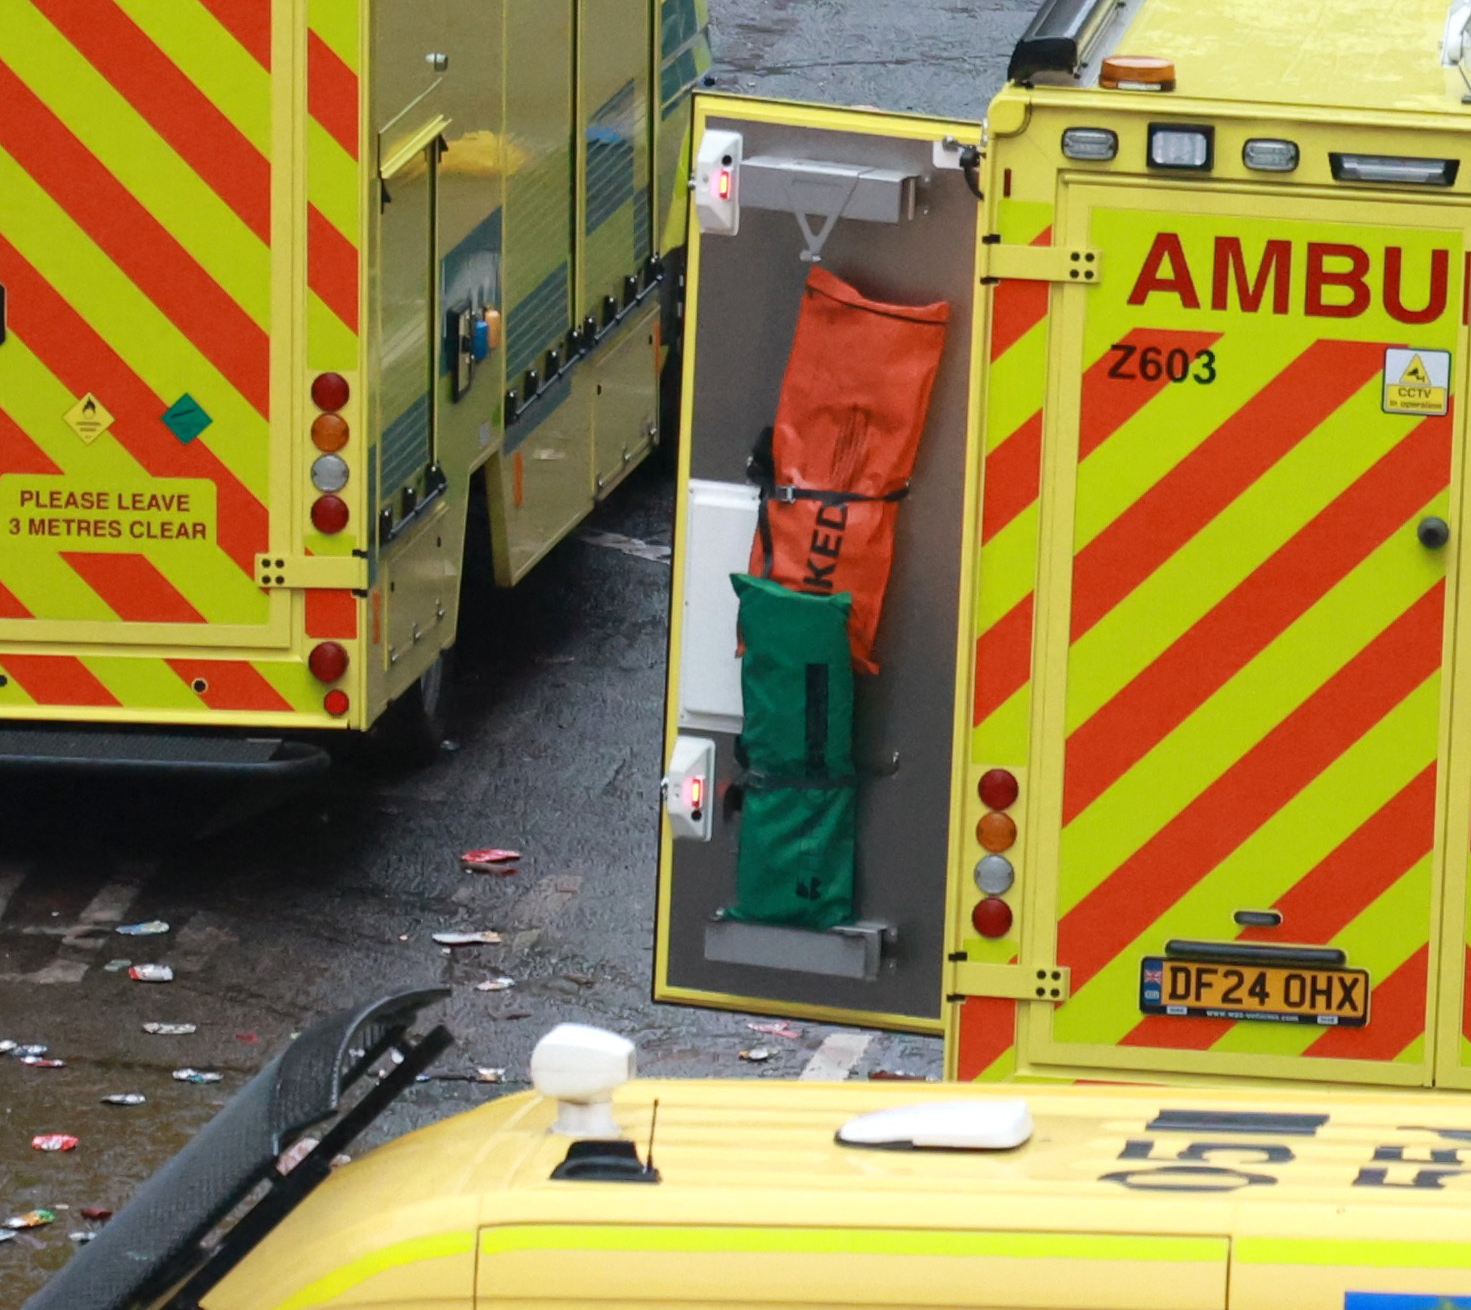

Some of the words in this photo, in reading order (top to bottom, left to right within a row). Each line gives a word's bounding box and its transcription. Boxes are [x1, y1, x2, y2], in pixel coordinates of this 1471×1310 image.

[1108, 344, 1216, 385] Z603
[1398, 387, 1432, 399] CCTV
[1400, 401, 1442, 411] operation
[20, 490, 109, 510] PLEASE
[118, 493, 190, 512] LEAVE
[9, 518, 20, 535] 3
[29, 518, 122, 538] METRES
[130, 521, 206, 540] CLEAR
[1169, 966, 1269, 1006] DF24
[1284, 973, 1360, 1011] OHX
